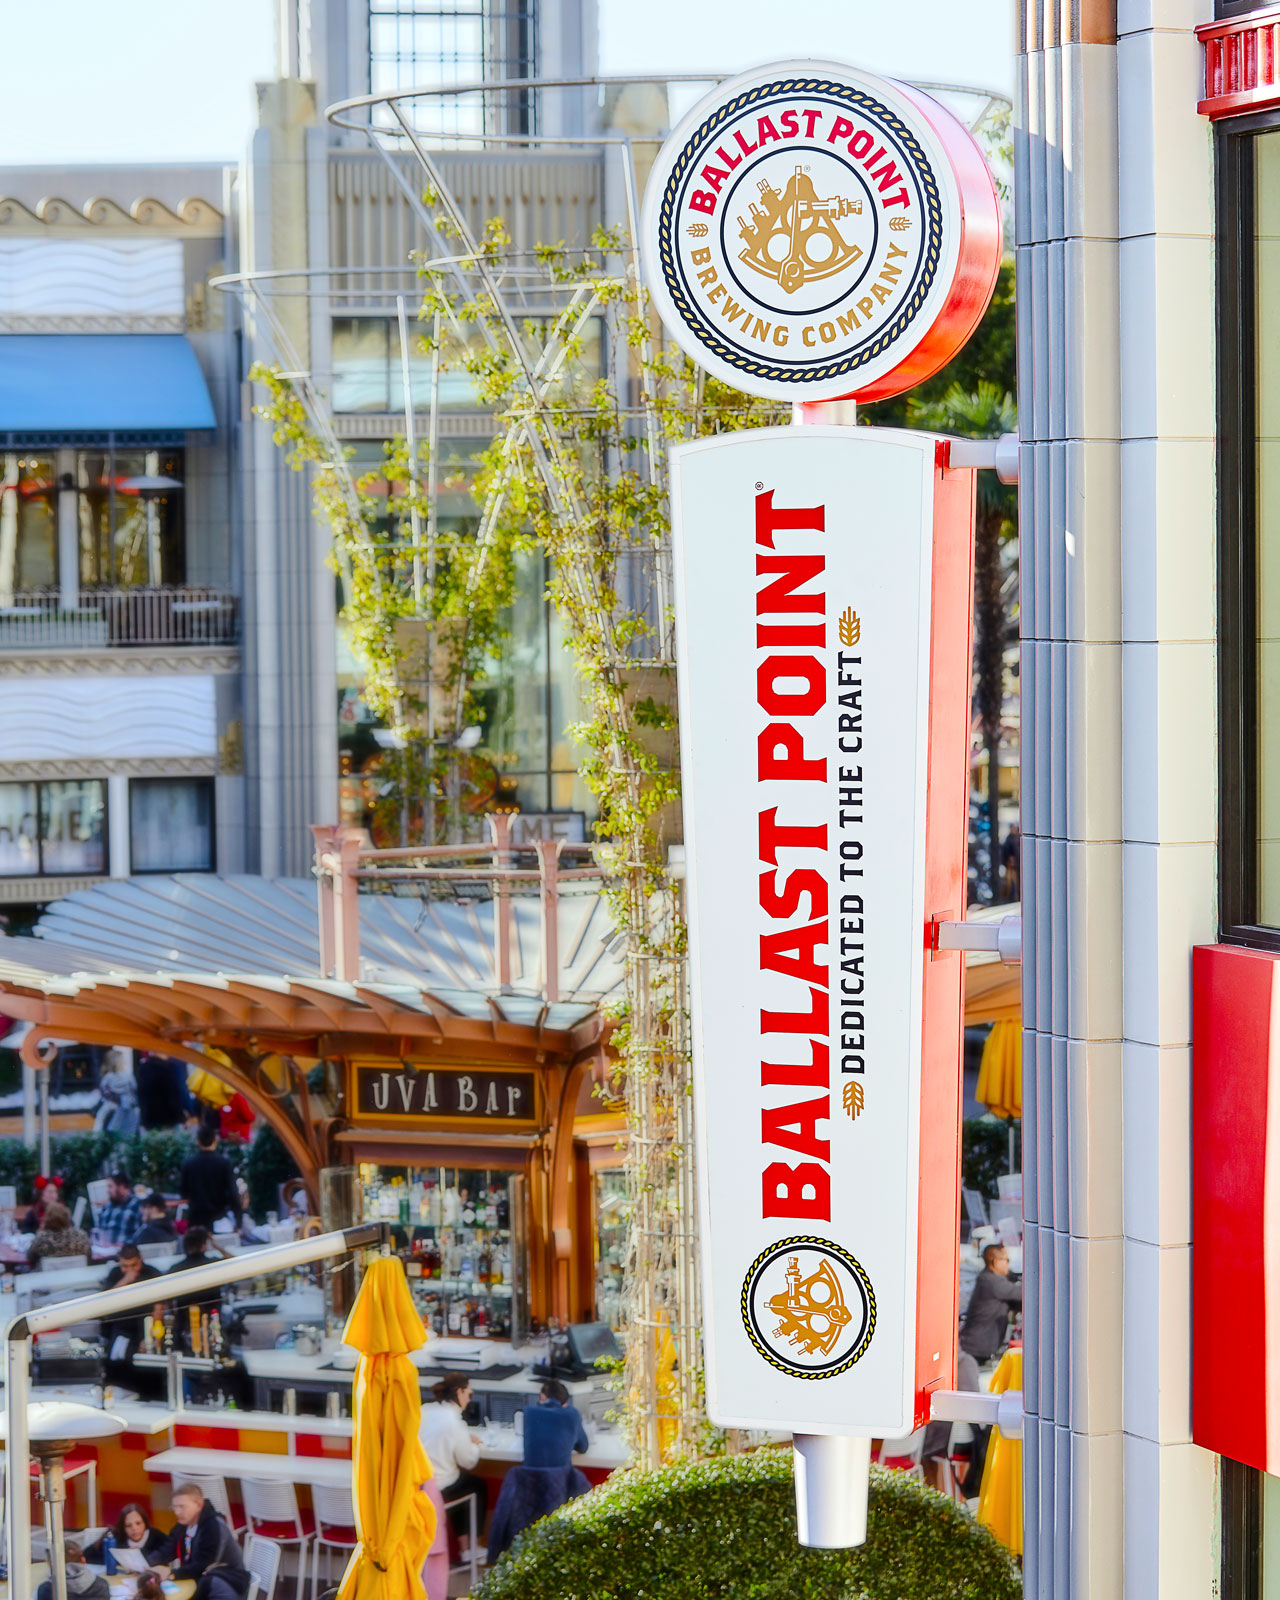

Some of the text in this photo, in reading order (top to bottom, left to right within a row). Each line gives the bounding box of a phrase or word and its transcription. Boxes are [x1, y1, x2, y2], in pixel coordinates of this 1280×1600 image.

[688, 109, 911, 216] BALLAST POINT
[690, 241, 909, 347] BREWING COMPANY
[755, 488, 831, 1223] BALLAST POINT
[837, 650, 865, 1075] DEDICATED TO THE CRAFT
[372, 1072, 439, 1113] UVA
